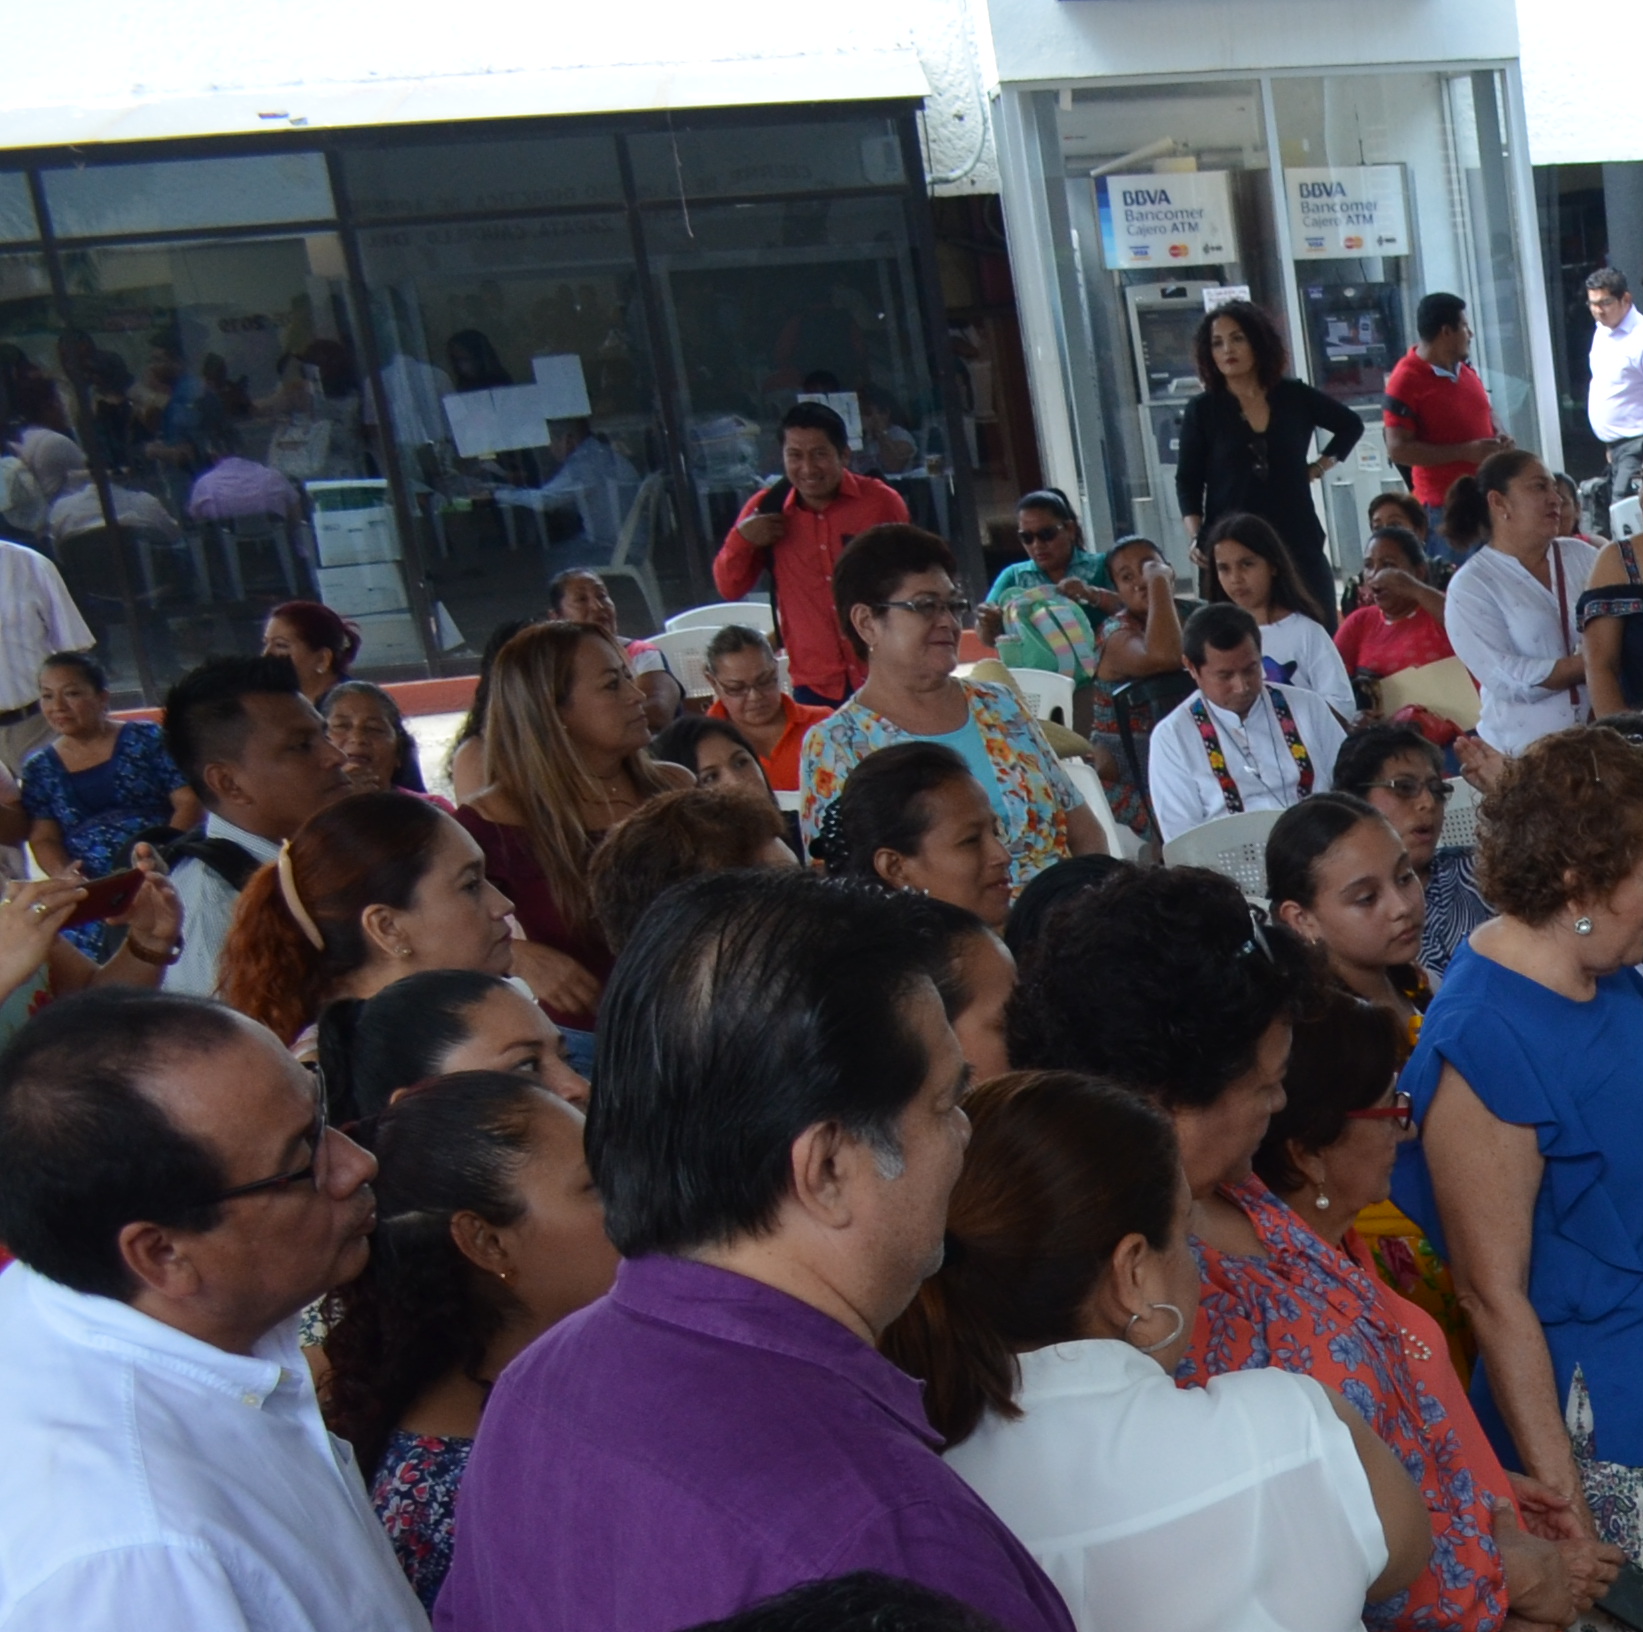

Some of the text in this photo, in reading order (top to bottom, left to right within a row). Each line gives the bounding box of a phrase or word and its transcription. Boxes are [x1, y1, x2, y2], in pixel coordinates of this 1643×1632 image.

[1123, 189, 1172, 206] BBVA
[1299, 182, 1346, 198] BBVA
[1125, 208, 1204, 222] Bancomer
[1301, 201, 1377, 214] Bancomer
[1303, 214, 1374, 229] Cajero ATM
[1127, 222, 1199, 237] Cajero ATM
